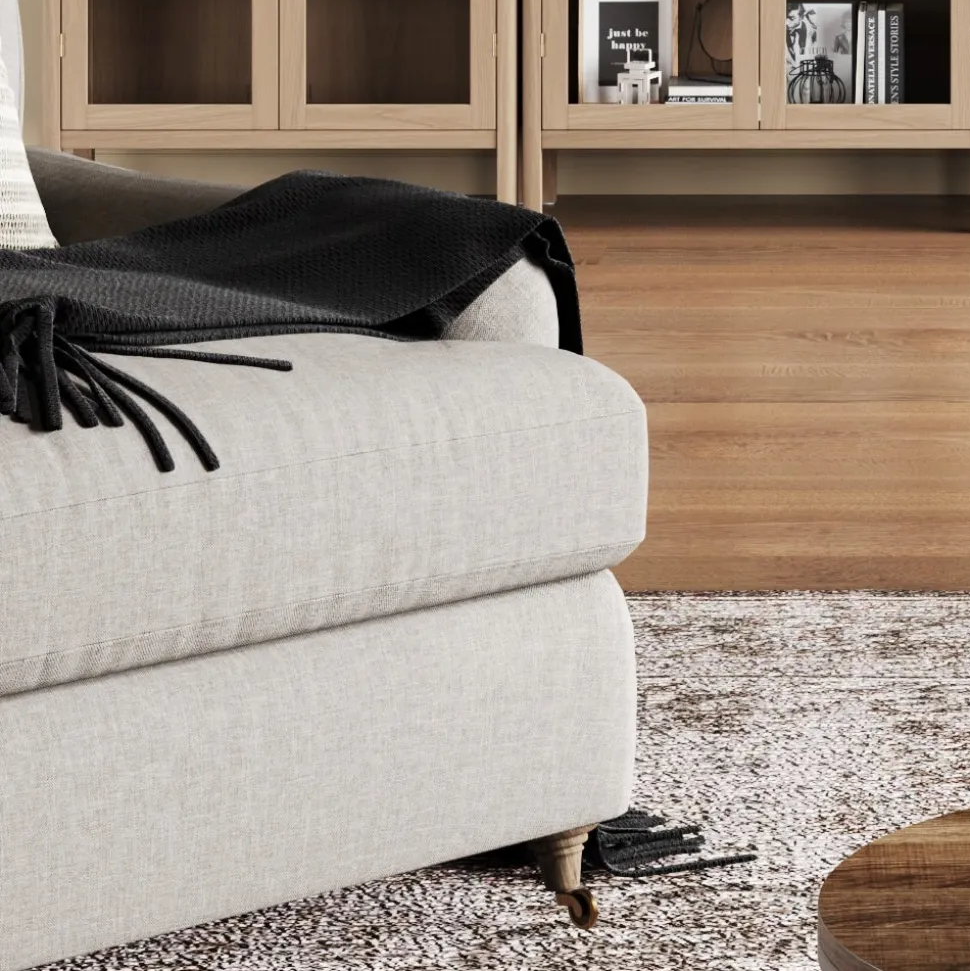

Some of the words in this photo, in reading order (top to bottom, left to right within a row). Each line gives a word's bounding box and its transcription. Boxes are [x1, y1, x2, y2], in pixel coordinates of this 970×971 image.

[607, 28, 631, 40] just
[635, 28, 649, 38] be
[611, 40, 646, 52] happy
[868, 17, 876, 59] VERSACE
[890, 15, 899, 54] STORIES
[890, 55, 899, 83] STYLE
